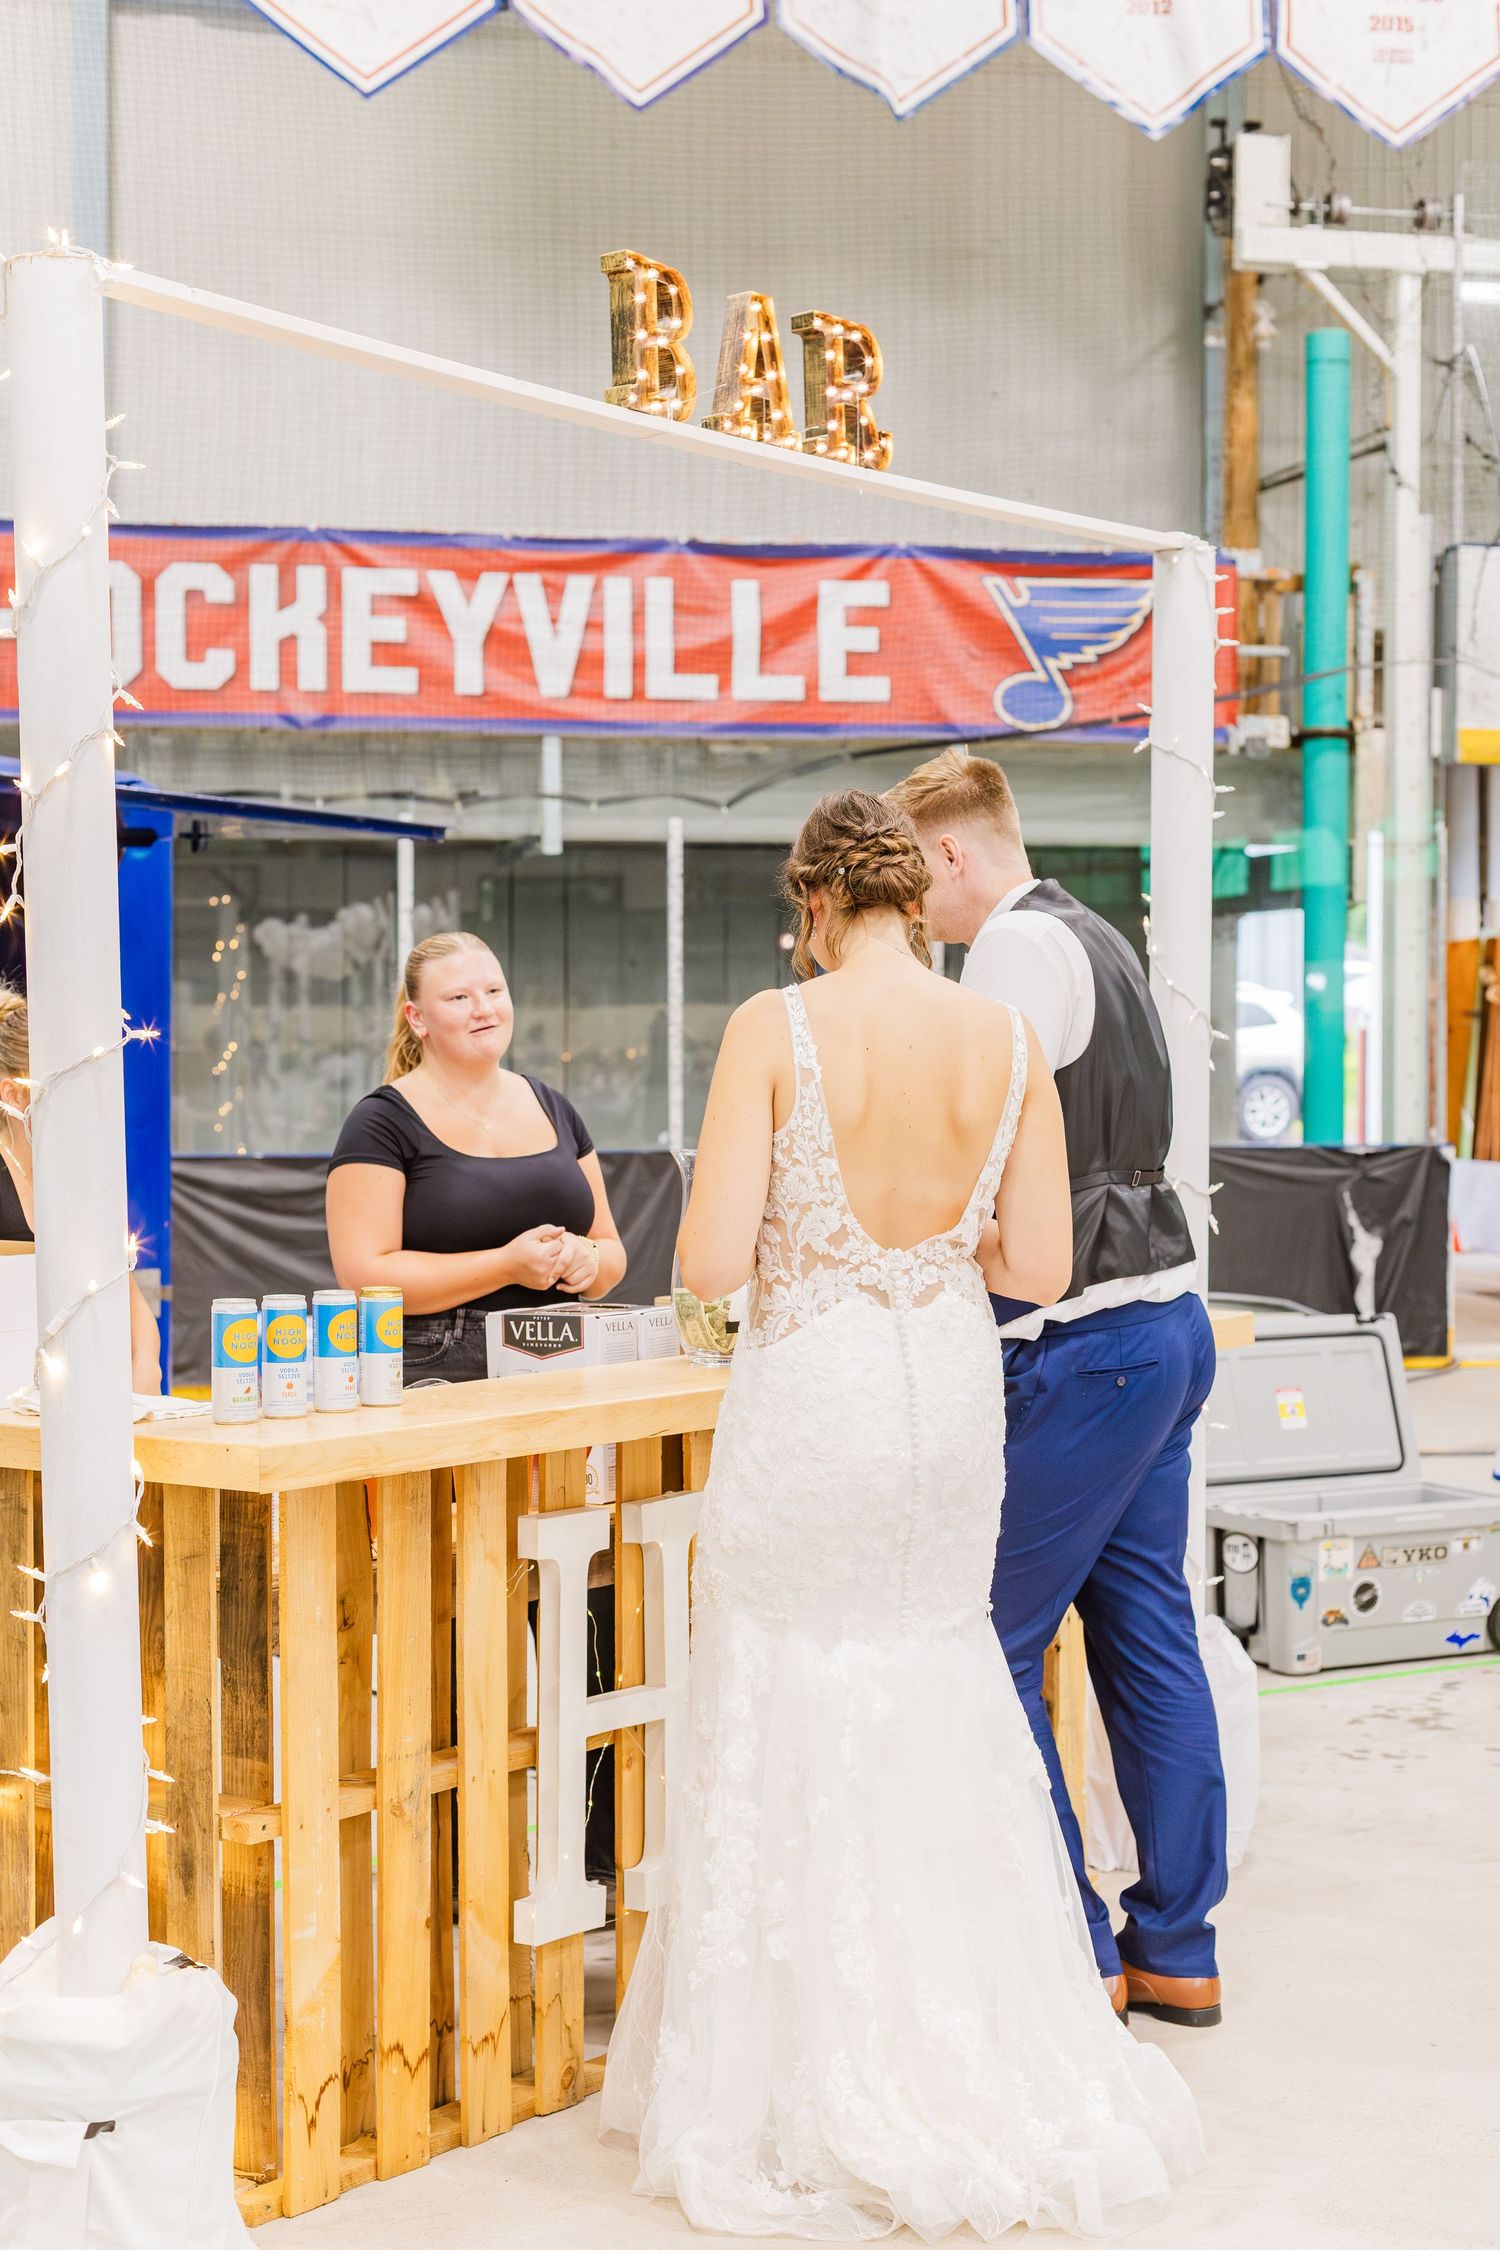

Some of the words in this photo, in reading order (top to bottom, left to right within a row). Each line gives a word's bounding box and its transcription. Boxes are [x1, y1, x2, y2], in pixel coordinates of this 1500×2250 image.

[1369, 15, 1414, 32] 2015
[600, 248, 893, 472] BAR
[605, 1320, 634, 1331] VELLA
[275, 1328, 303, 1336] HIGH
[273, 1337, 304, 1345] NOON
